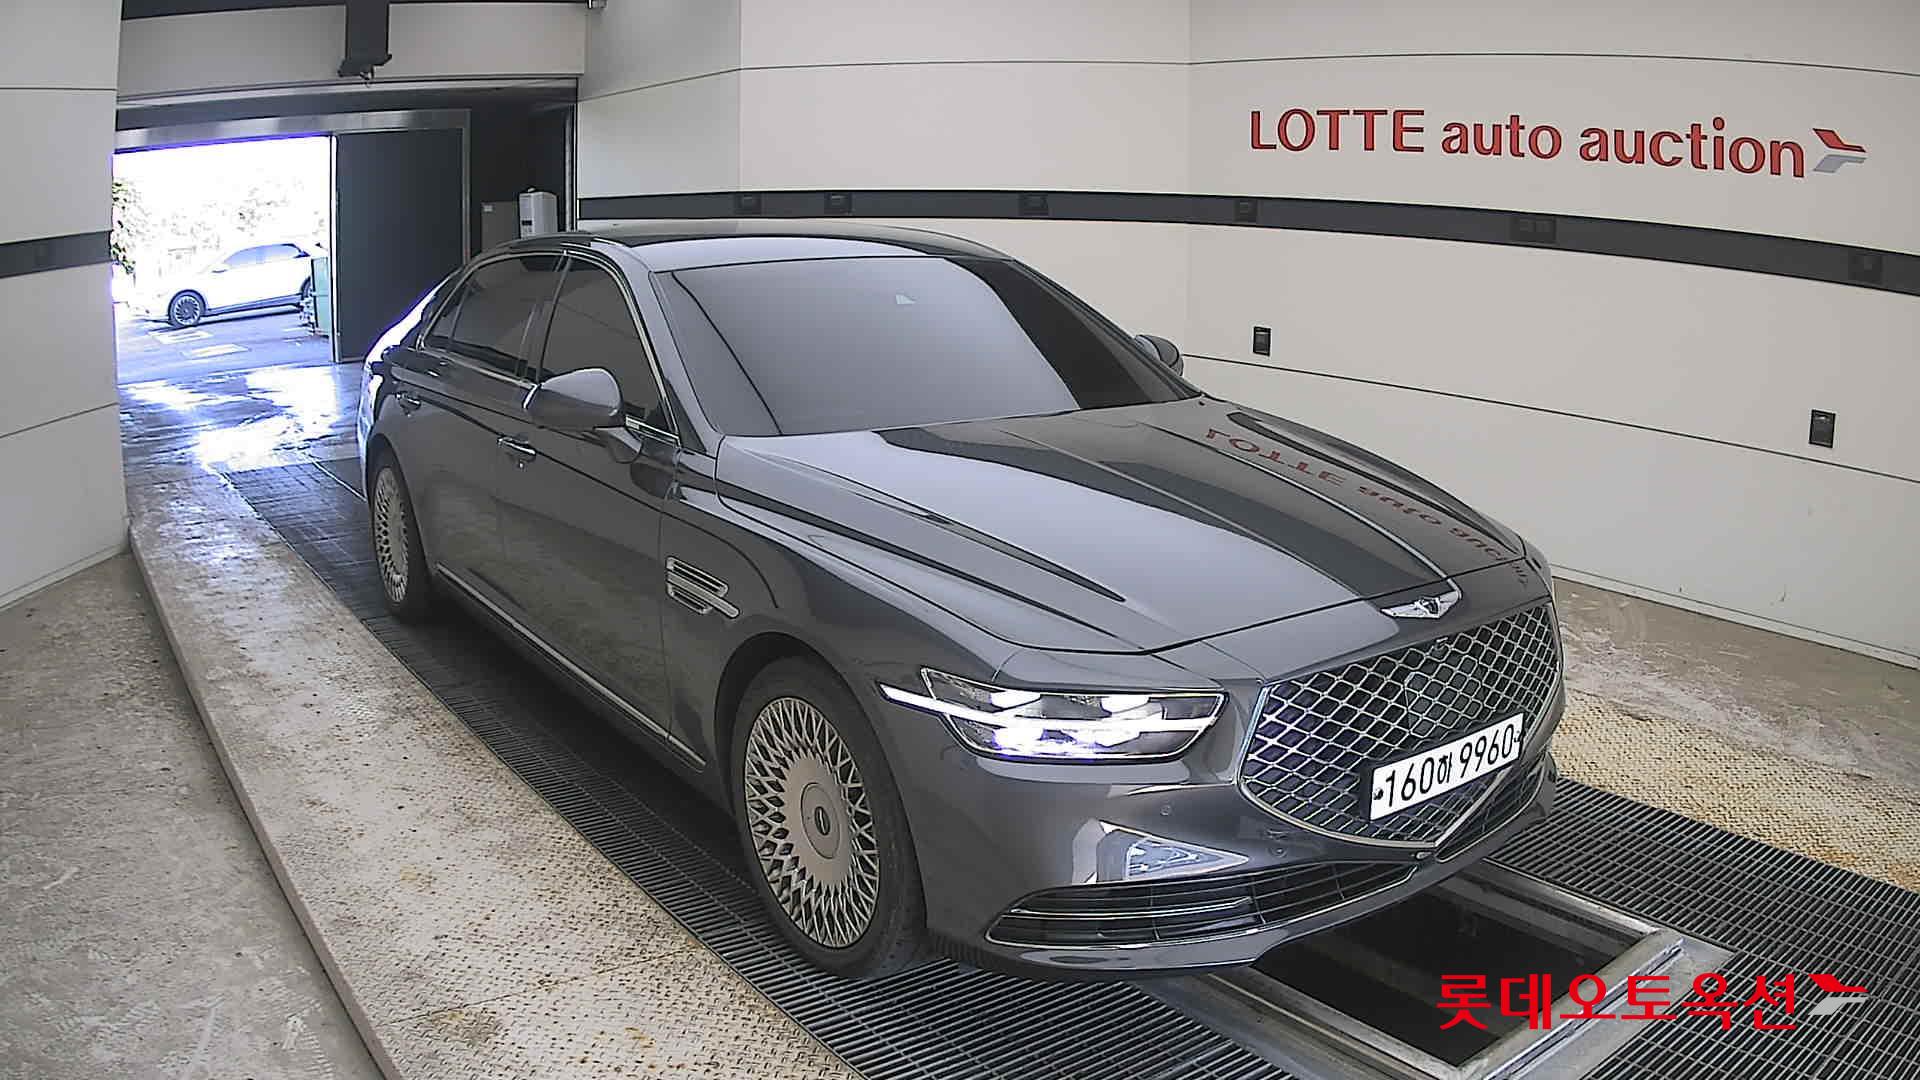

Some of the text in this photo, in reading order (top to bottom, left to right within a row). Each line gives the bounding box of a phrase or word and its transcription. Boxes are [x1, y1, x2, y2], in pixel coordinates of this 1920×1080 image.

[1250, 109, 1805, 178] LOTTE auto auction
[1385, 723, 1515, 808] 160하 9960
